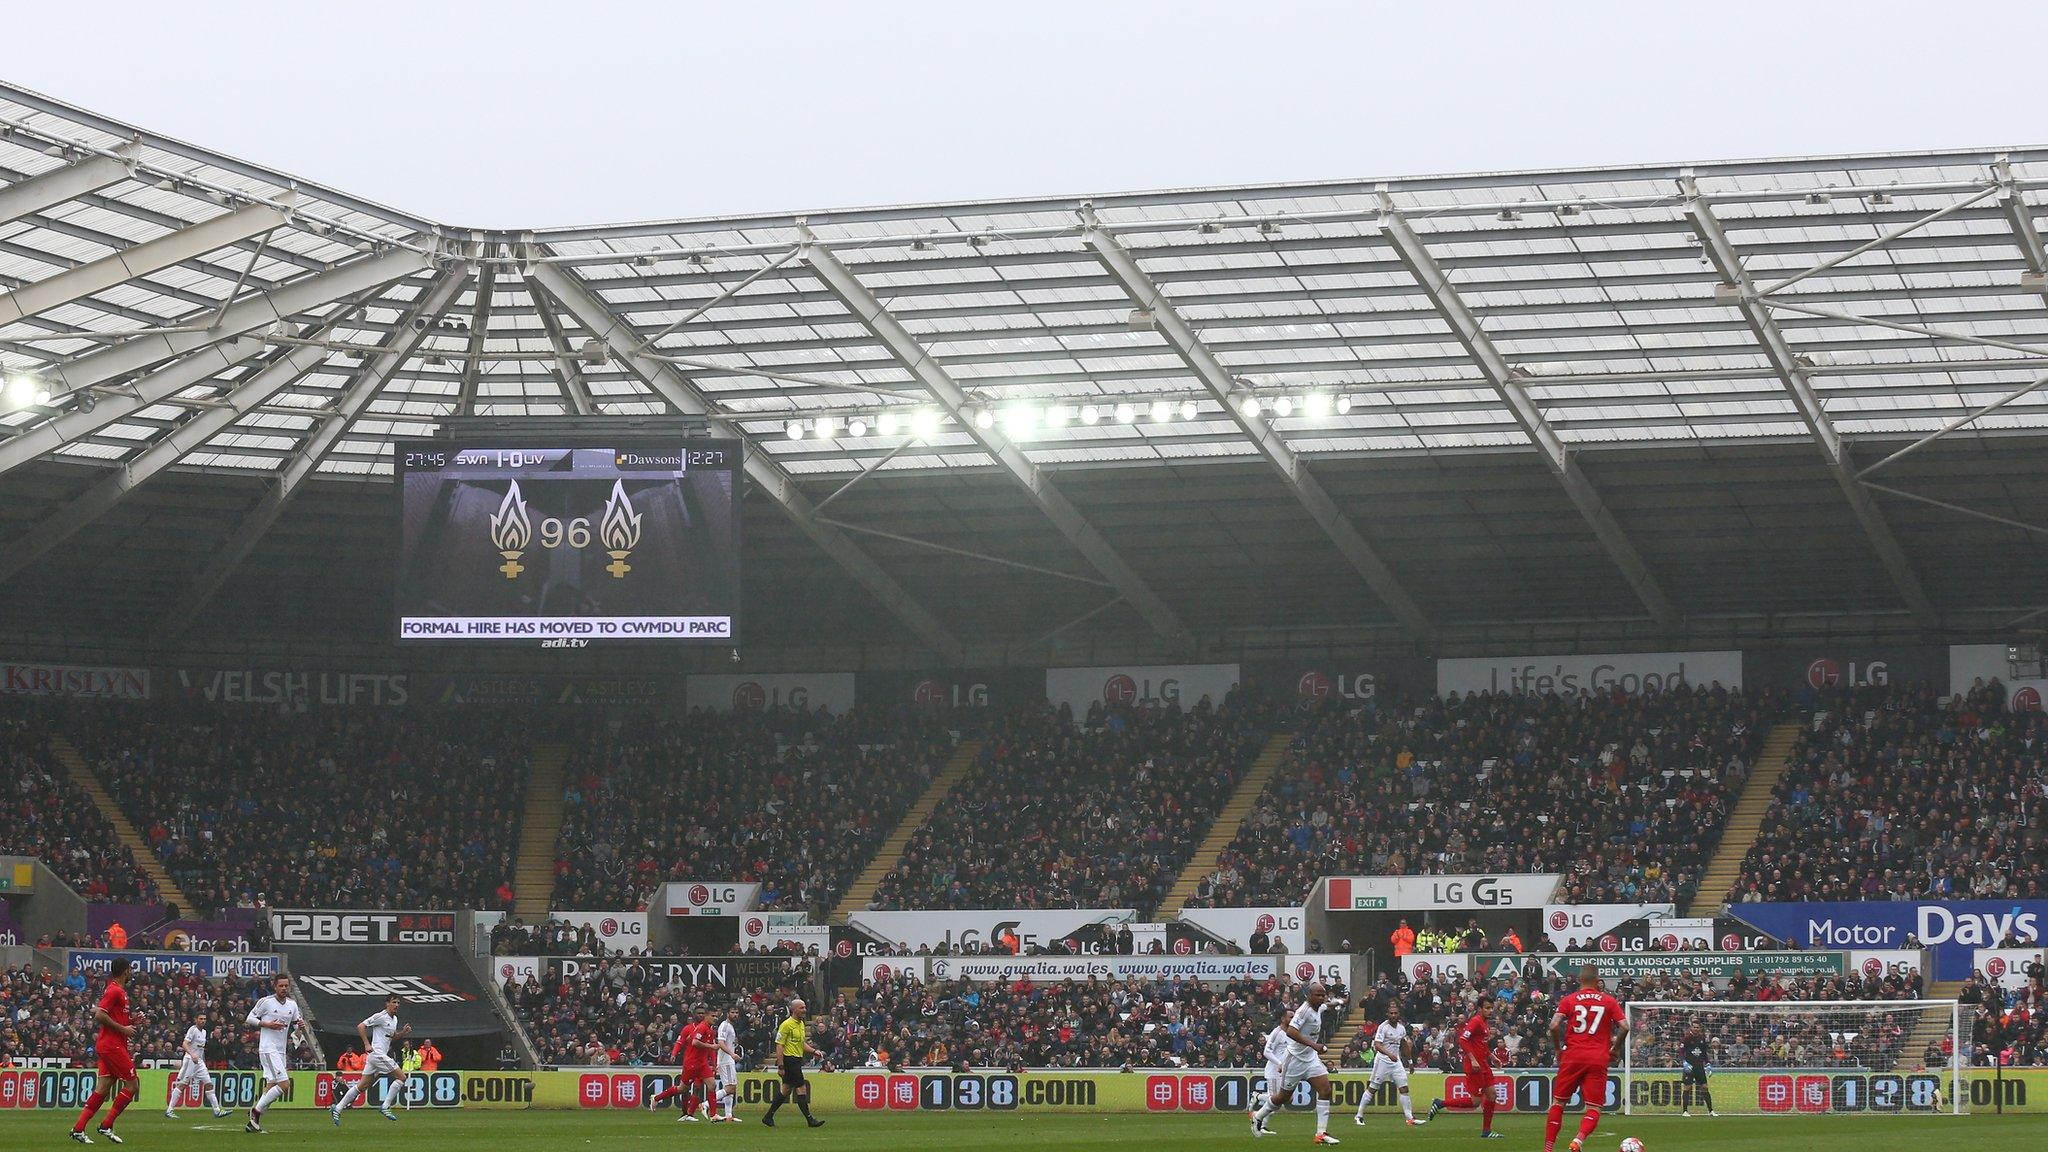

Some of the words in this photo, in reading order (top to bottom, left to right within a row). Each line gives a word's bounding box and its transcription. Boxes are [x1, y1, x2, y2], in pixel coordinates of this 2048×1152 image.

[406, 453, 445, 467] 27:45
[628, 454, 680, 465] Dawsons
[688, 451, 724, 465] 12:27
[541, 517, 591, 549] 96
[403, 622, 463, 634] FORMAL
[467, 622, 502, 634] HIRE
[505, 622, 535, 634] HAS
[540, 622, 593, 634] MOVED
[597, 621, 617, 633] TO
[622, 621, 685, 633] CWMDU
[689, 621, 727, 633] PARC
[541, 638, 589, 648] adi.tv
[1849, 661, 1888, 687] LG
[321, 673, 408, 705] LIFTS
[1144, 678, 1180, 702] LG
[1338, 673, 1375, 699] LG
[953, 683, 988, 707] LG
[712, 888, 736, 903] LG
[1433, 882, 1463, 904] LG
[1278, 916, 1299, 930] LG
[1572, 913, 1593, 928] LG
[1808, 919, 1896, 944] Motor
[1917, 905, 2038, 949] Day's
[621, 921, 641, 935] LG
[856, 942, 877, 956] LG
[1081, 941, 1100, 955] LG
[1621, 937, 1644, 951] LG
[75, 955, 141, 972] Swana
[146, 957, 199, 975] Timber
[1569, 957, 1615, 967] FENCING
[1617, 957, 1626, 966] &
[1628, 957, 1690, 966] LANDSCAPE
[1692, 956, 1743, 966] SUPPLIES
[1748, 956, 1763, 964] Tel:
[1764, 956, 1789, 964] 01792
[1791, 955, 1802, 963] 89
[1817, 955, 1828, 963] 40
[517, 966, 533, 977] LG
[736, 962, 780, 974] WELSH
[961, 962, 1108, 978] www.gwalia.wales
[1118, 961, 1269, 977] www.gwalia.wales
[1318, 963, 1340, 979] LG
[1436, 965, 1458, 978] LG
[1598, 968, 1619, 976] PEN
[300, 975, 441, 996] 12BET
[1572, 1004, 1606, 1035] 37
[9, 1056, 72, 1070] 2BET
